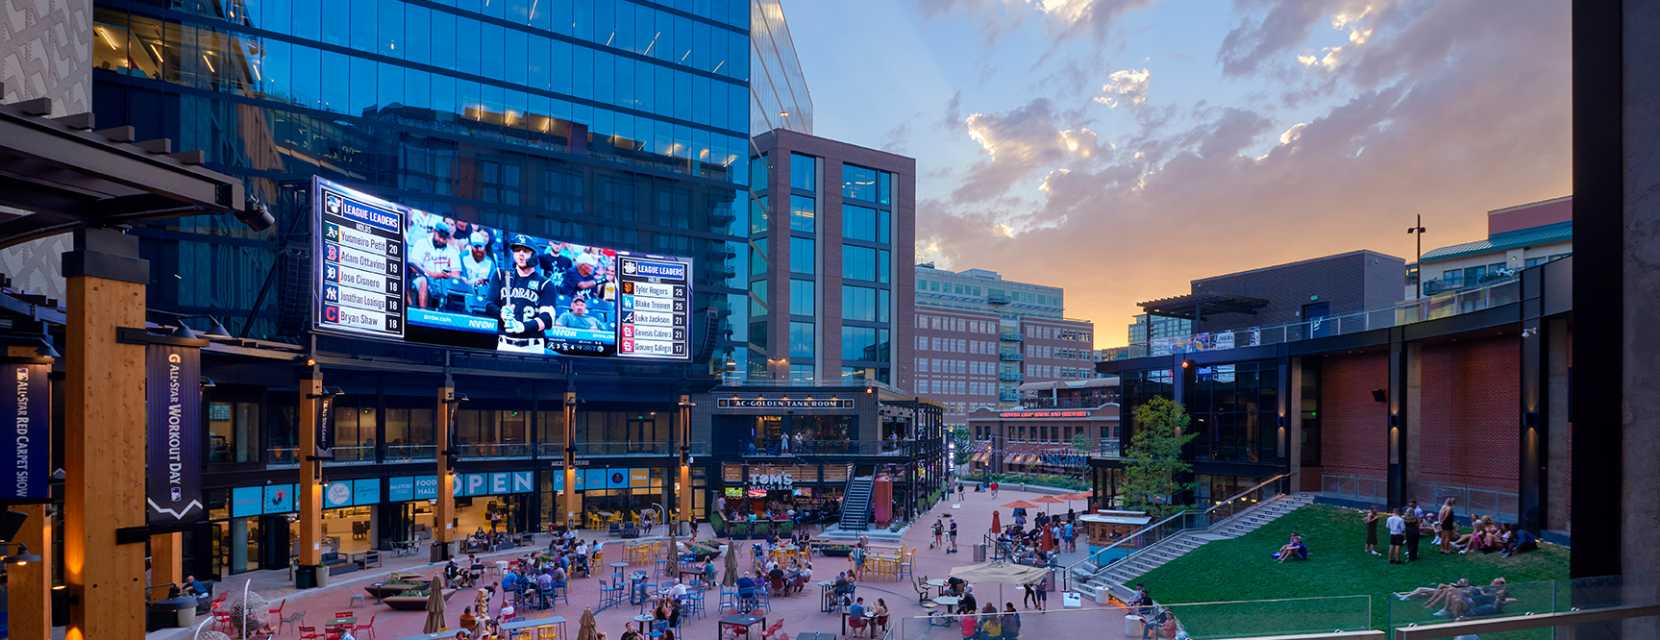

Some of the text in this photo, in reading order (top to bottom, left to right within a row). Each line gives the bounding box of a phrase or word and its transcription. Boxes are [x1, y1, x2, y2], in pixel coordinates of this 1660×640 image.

[344, 203, 398, 228] LEAGUE LEADERS
[371, 239, 386, 251] Petit
[389, 244, 398, 255] 20
[341, 251, 398, 273] Adam Ottavino 19
[638, 264, 684, 277] LEAGUE LEADERS
[341, 271, 355, 284] Jose
[389, 282, 398, 292] 18
[389, 301, 398, 311] 18
[341, 310, 398, 329] Bryan Shaw 18
[787, 399, 809, 407] TANK
[811, 399, 837, 407] ROOM
[16, 416, 29, 436] RED
[168, 404, 182, 461] WORKOUT
[16, 436, 29, 472] CARPET
[169, 462, 182, 485] DAY
[416, 479, 438, 487] FOOD
[752, 471, 793, 485] TOM'S
[16, 471, 29, 498] SHOW
